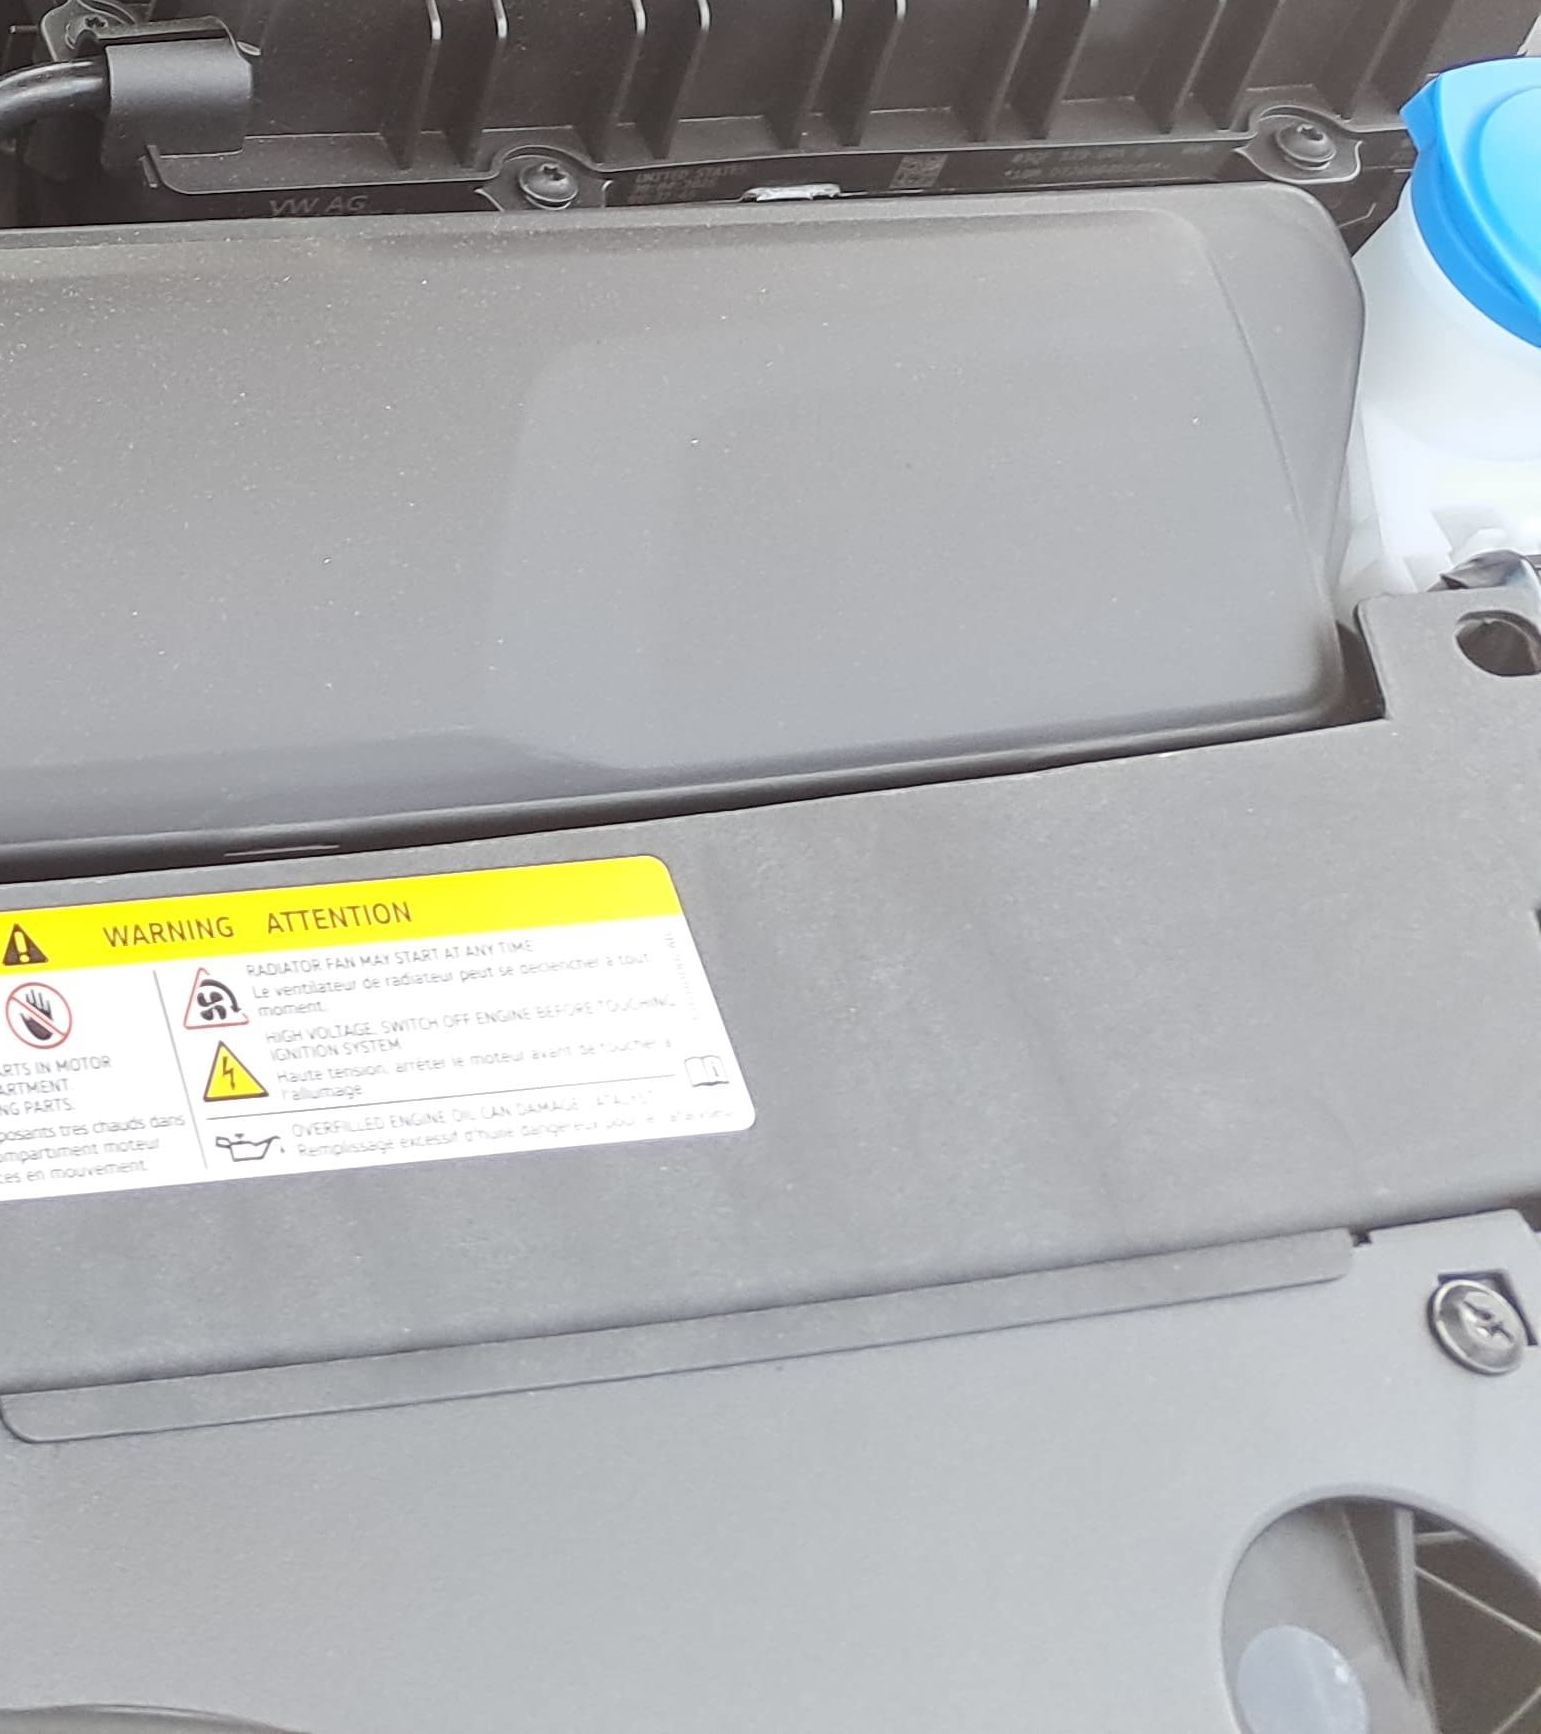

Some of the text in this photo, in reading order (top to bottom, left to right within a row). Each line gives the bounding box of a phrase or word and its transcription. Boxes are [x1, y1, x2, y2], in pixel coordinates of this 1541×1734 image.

[103, 901, 412, 947] WARNING ATTENTION
[246, 940, 533, 977] RADIATOR FAN MAY START AT ANY TIME
[253, 985, 269, 999] Le
[276, 980, 356, 996] ventilateur
[362, 975, 381, 990] de
[386, 971, 453, 987] radiateur
[460, 966, 493, 982] peut
[266, 1028, 302, 1043] HIGH
[381, 1017, 437, 1034] SWITCH
[443, 1013, 470, 1028] OFF
[477, 1008, 531, 1024] ENGINE
[271, 1042, 339, 1061] IGNITION
[35, 1061, 51, 1075] IN
[55, 1055, 111, 1073] MOTOR
[277, 1069, 323, 1084] Haute
[93, 1117, 146, 1134] chauds
[150, 1115, 185, 1128] dans
[292, 1117, 385, 1137] OVERFILLED
[390, 1111, 446, 1129] ENGINE
[104, 1138, 160, 1154] moteur
[297, 1139, 394, 1156] Remplissage
[27, 1167, 45, 1181] en
